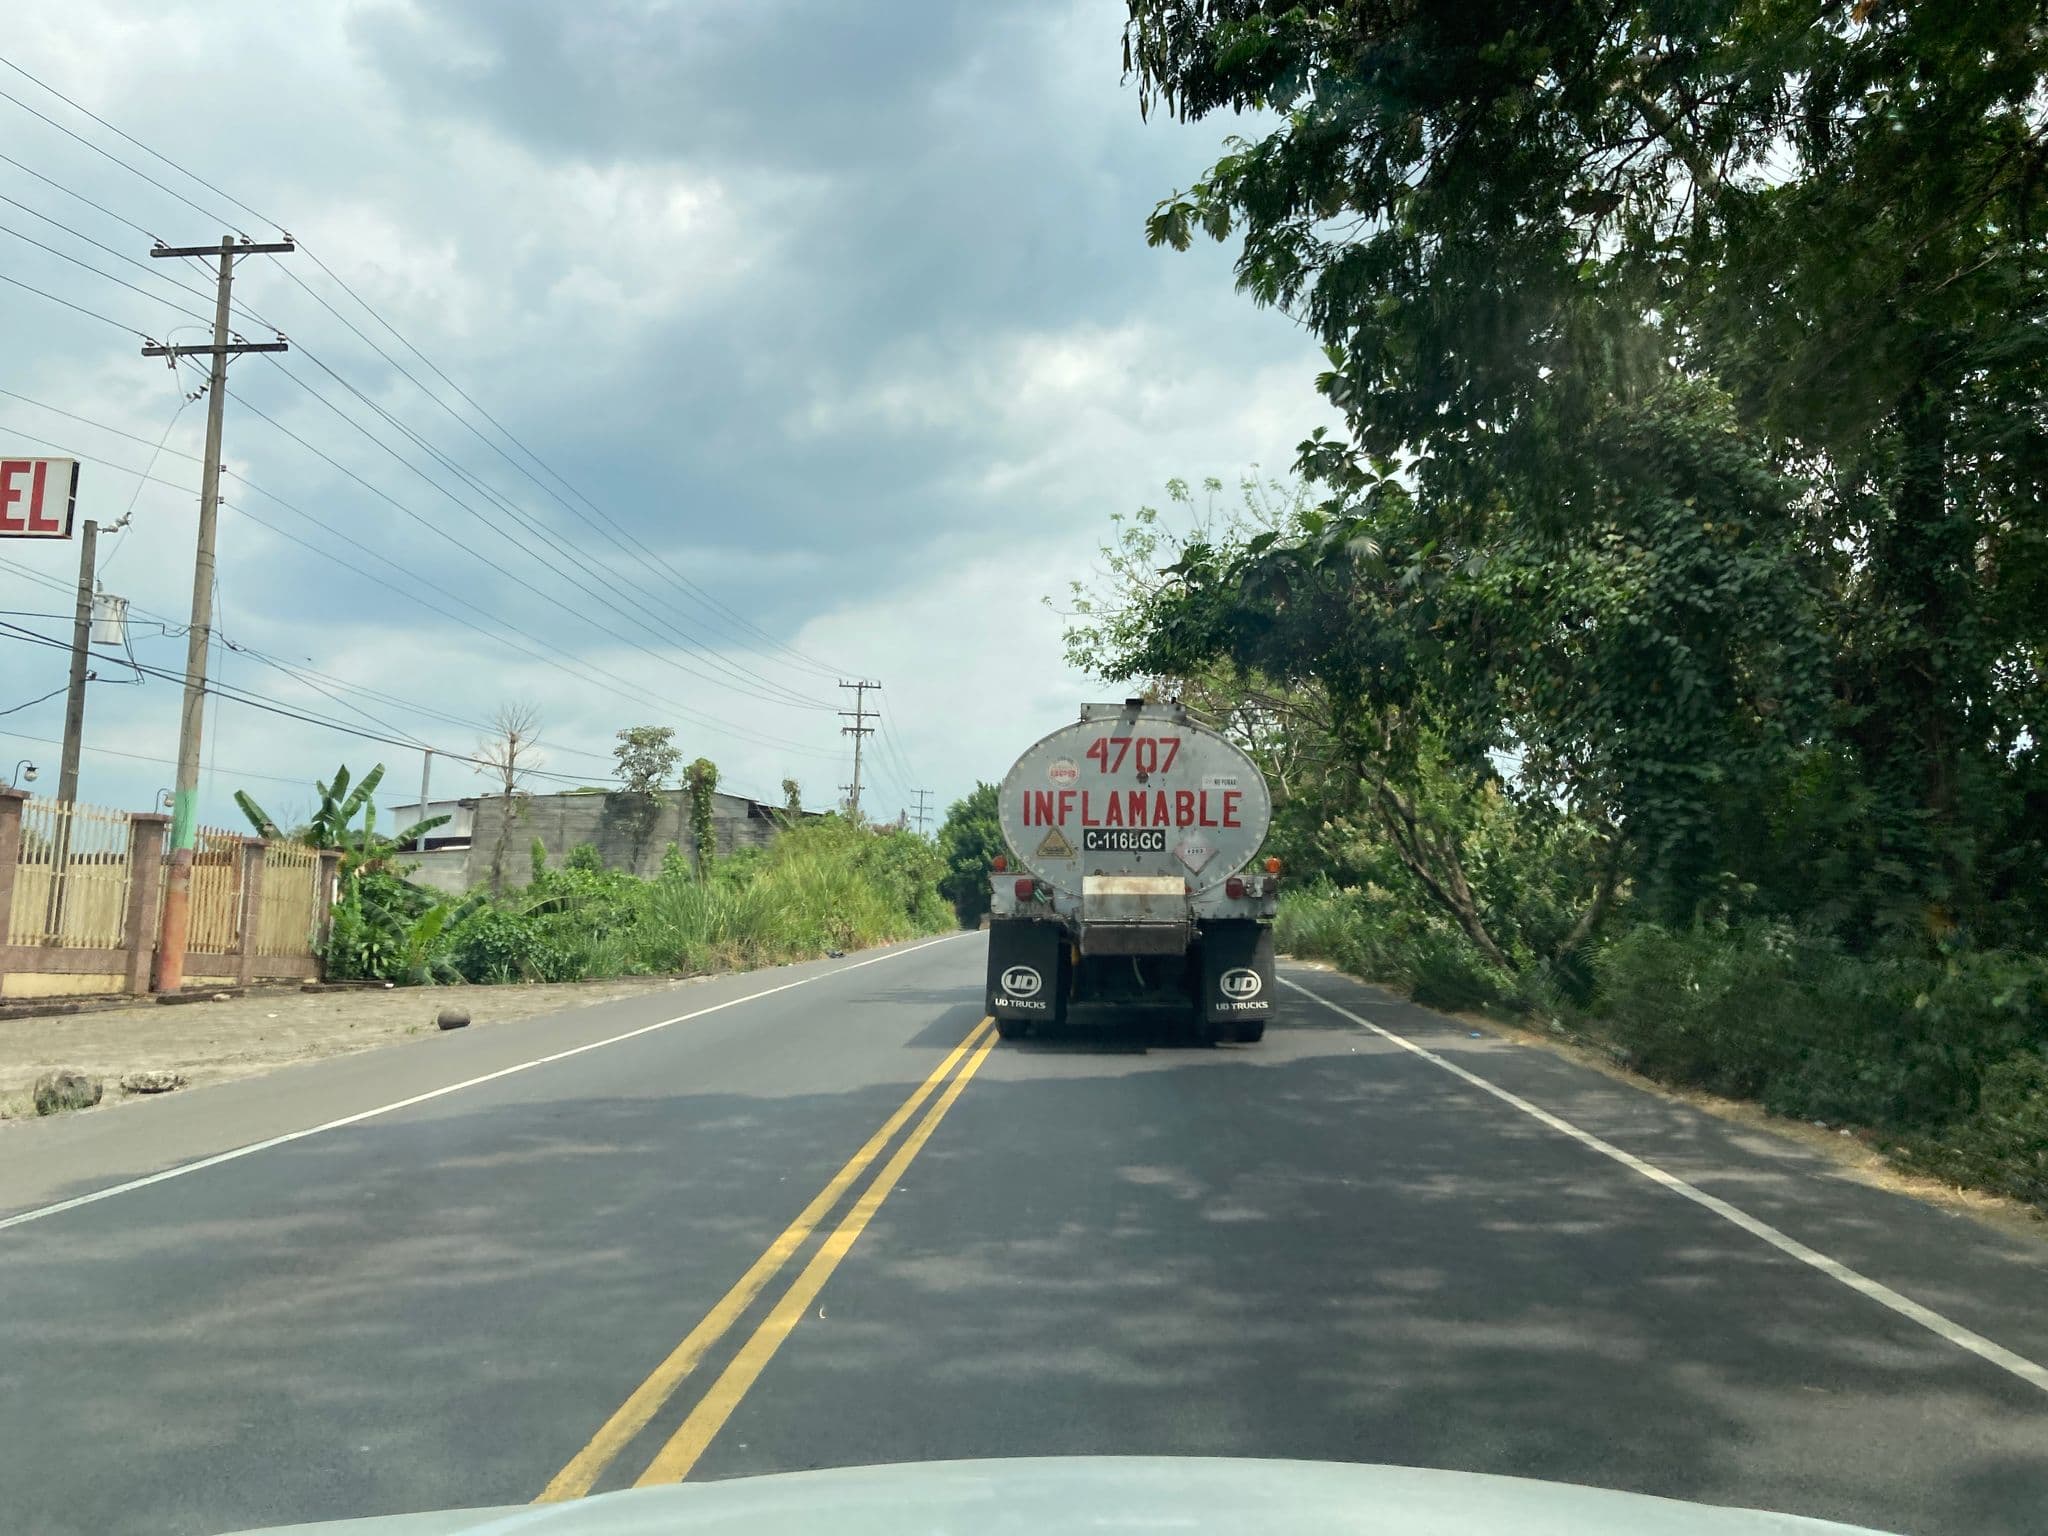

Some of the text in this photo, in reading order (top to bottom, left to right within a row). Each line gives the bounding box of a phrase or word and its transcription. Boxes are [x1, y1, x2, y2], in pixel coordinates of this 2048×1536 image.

[0, 461, 59, 531] EL
[1086, 737, 1181, 774] 4707
[1023, 790, 1243, 828] INFLAMABLE
[1087, 831, 1162, 849] C-116BGC
[1005, 974, 1038, 990] UD
[1224, 976, 1257, 992] UD
[995, 998, 1046, 1009] UD TRUCKS
[1231, 1001, 1268, 1010] TRUCKS
